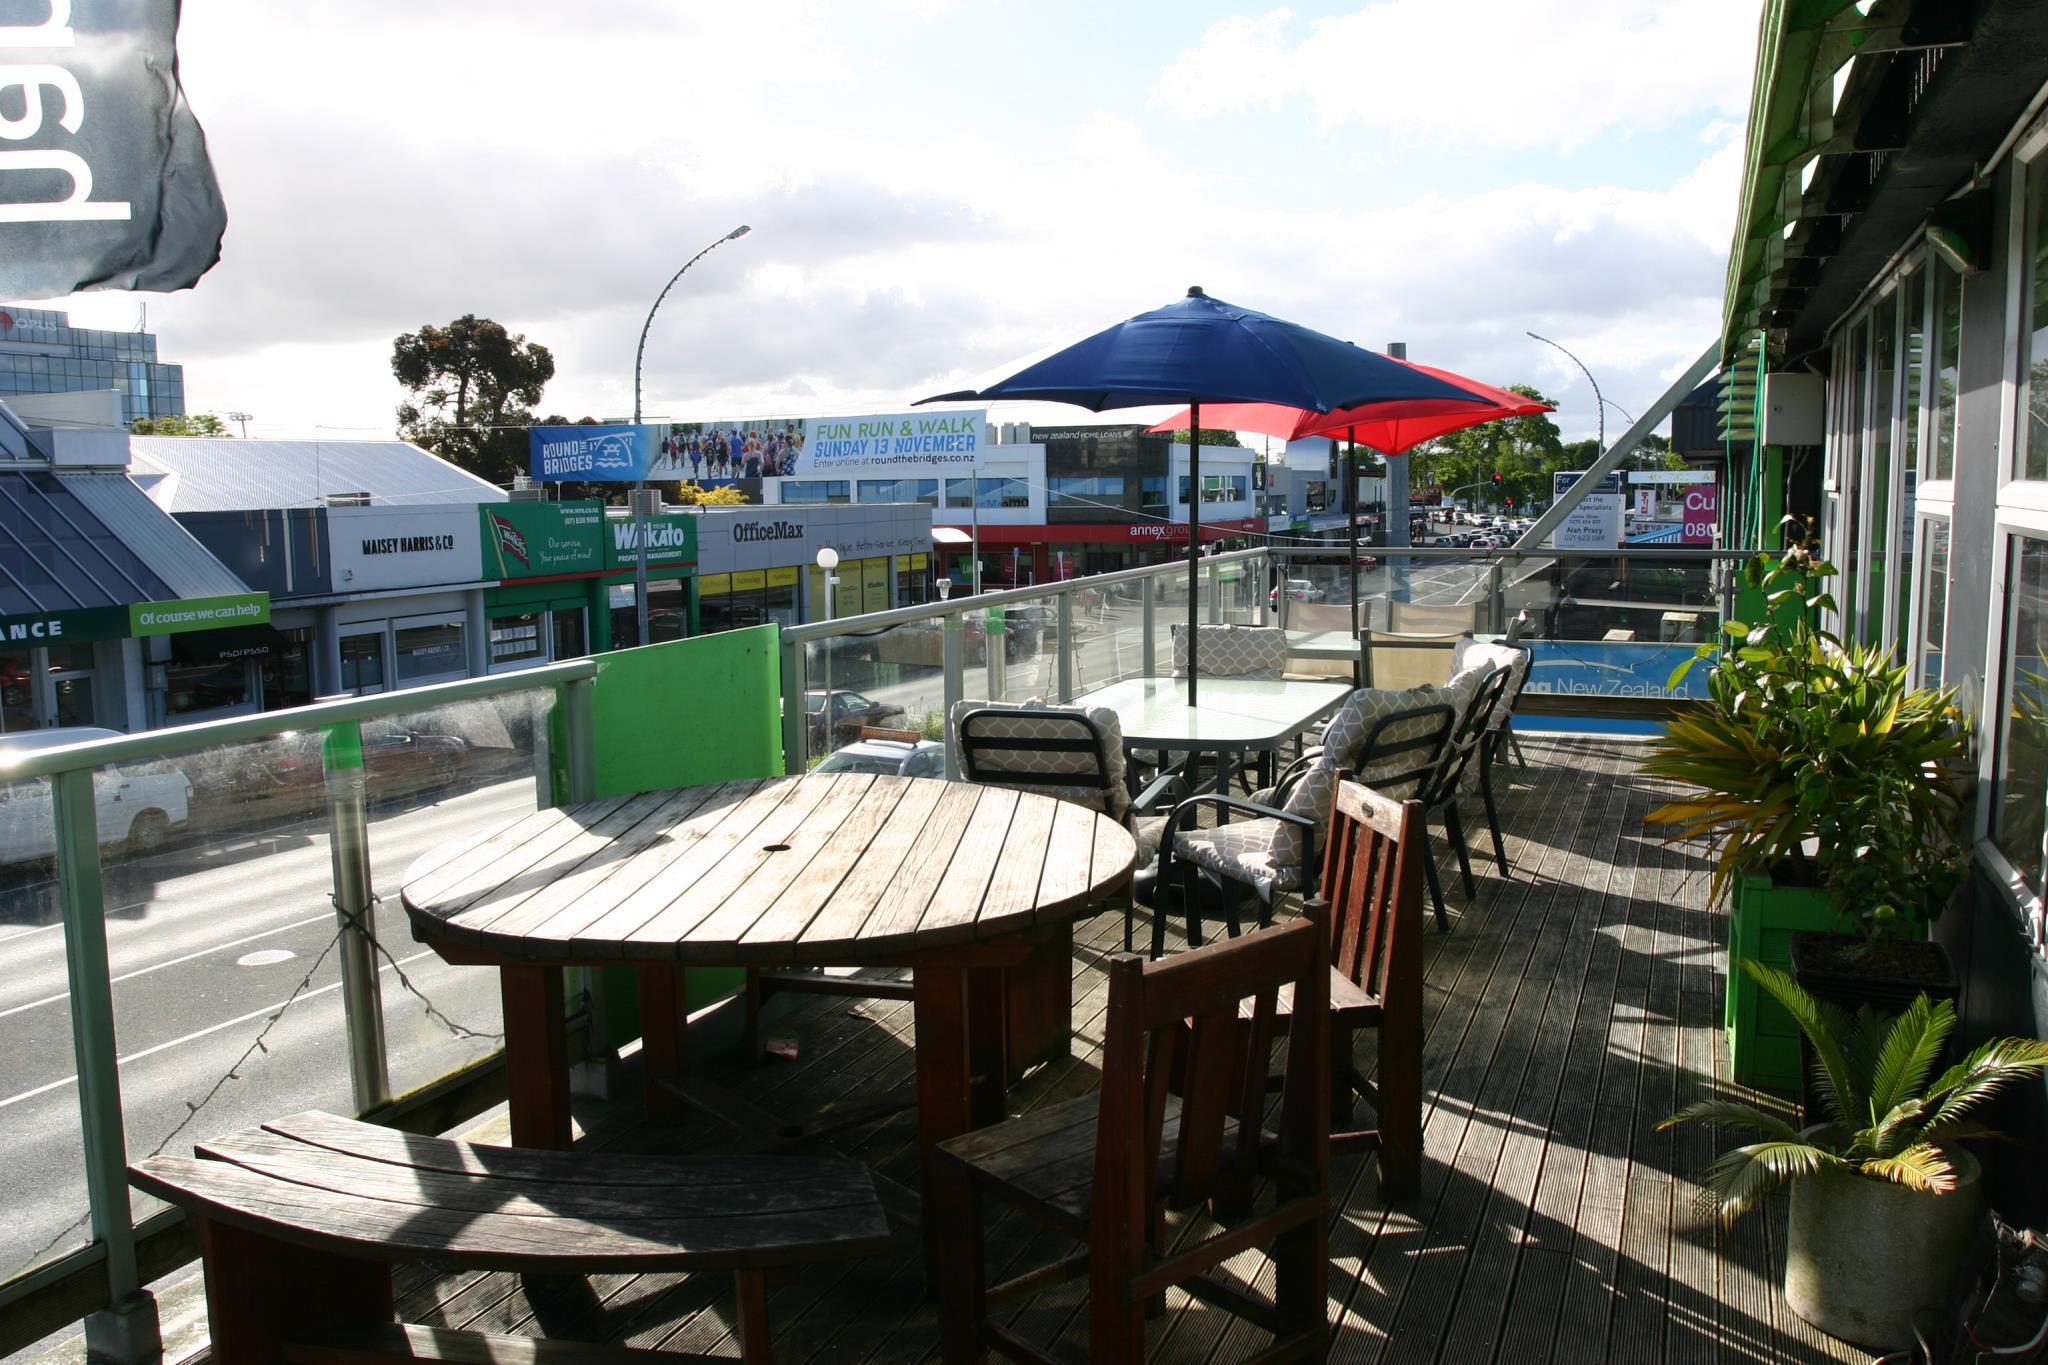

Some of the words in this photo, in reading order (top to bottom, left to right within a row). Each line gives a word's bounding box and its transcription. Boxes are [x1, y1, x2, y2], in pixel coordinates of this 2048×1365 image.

[16, 318, 57, 332] OPUS
[816, 424, 851, 440] FUN
[859, 421, 894, 438] RUN
[900, 420, 913, 436] &
[919, 417, 976, 434] WALK
[1050, 431, 1080, 440] zealand
[1100, 431, 1122, 439] LOANS
[543, 440, 579, 460] ROUND
[579, 439, 588, 454] THE
[815, 439, 869, 458] SUNDAY
[874, 438, 889, 455] 13
[895, 434, 976, 453] NOVEMBER
[544, 455, 593, 475] BRIDGES
[813, 459, 834, 468] Enter
[835, 457, 860, 467] online
[871, 454, 975, 465] roundthebridges.co.nz
[1556, 475, 1570, 484] For
[1686, 492, 1715, 511] Cu
[733, 521, 804, 543] OfficeMax
[362, 538, 398, 555] MAISEY
[400, 536, 434, 552] HARRIS
[435, 536, 442, 551] &
[646, 550, 682, 560] MANAGEMENT
[139, 612, 155, 625] Of
[156, 610, 196, 624] course
[197, 608, 213, 620] we
[215, 607, 236, 618] can
[237, 603, 261, 617] help
[0, 620, 63, 641] NCE
[1556, 677, 1603, 695] New
